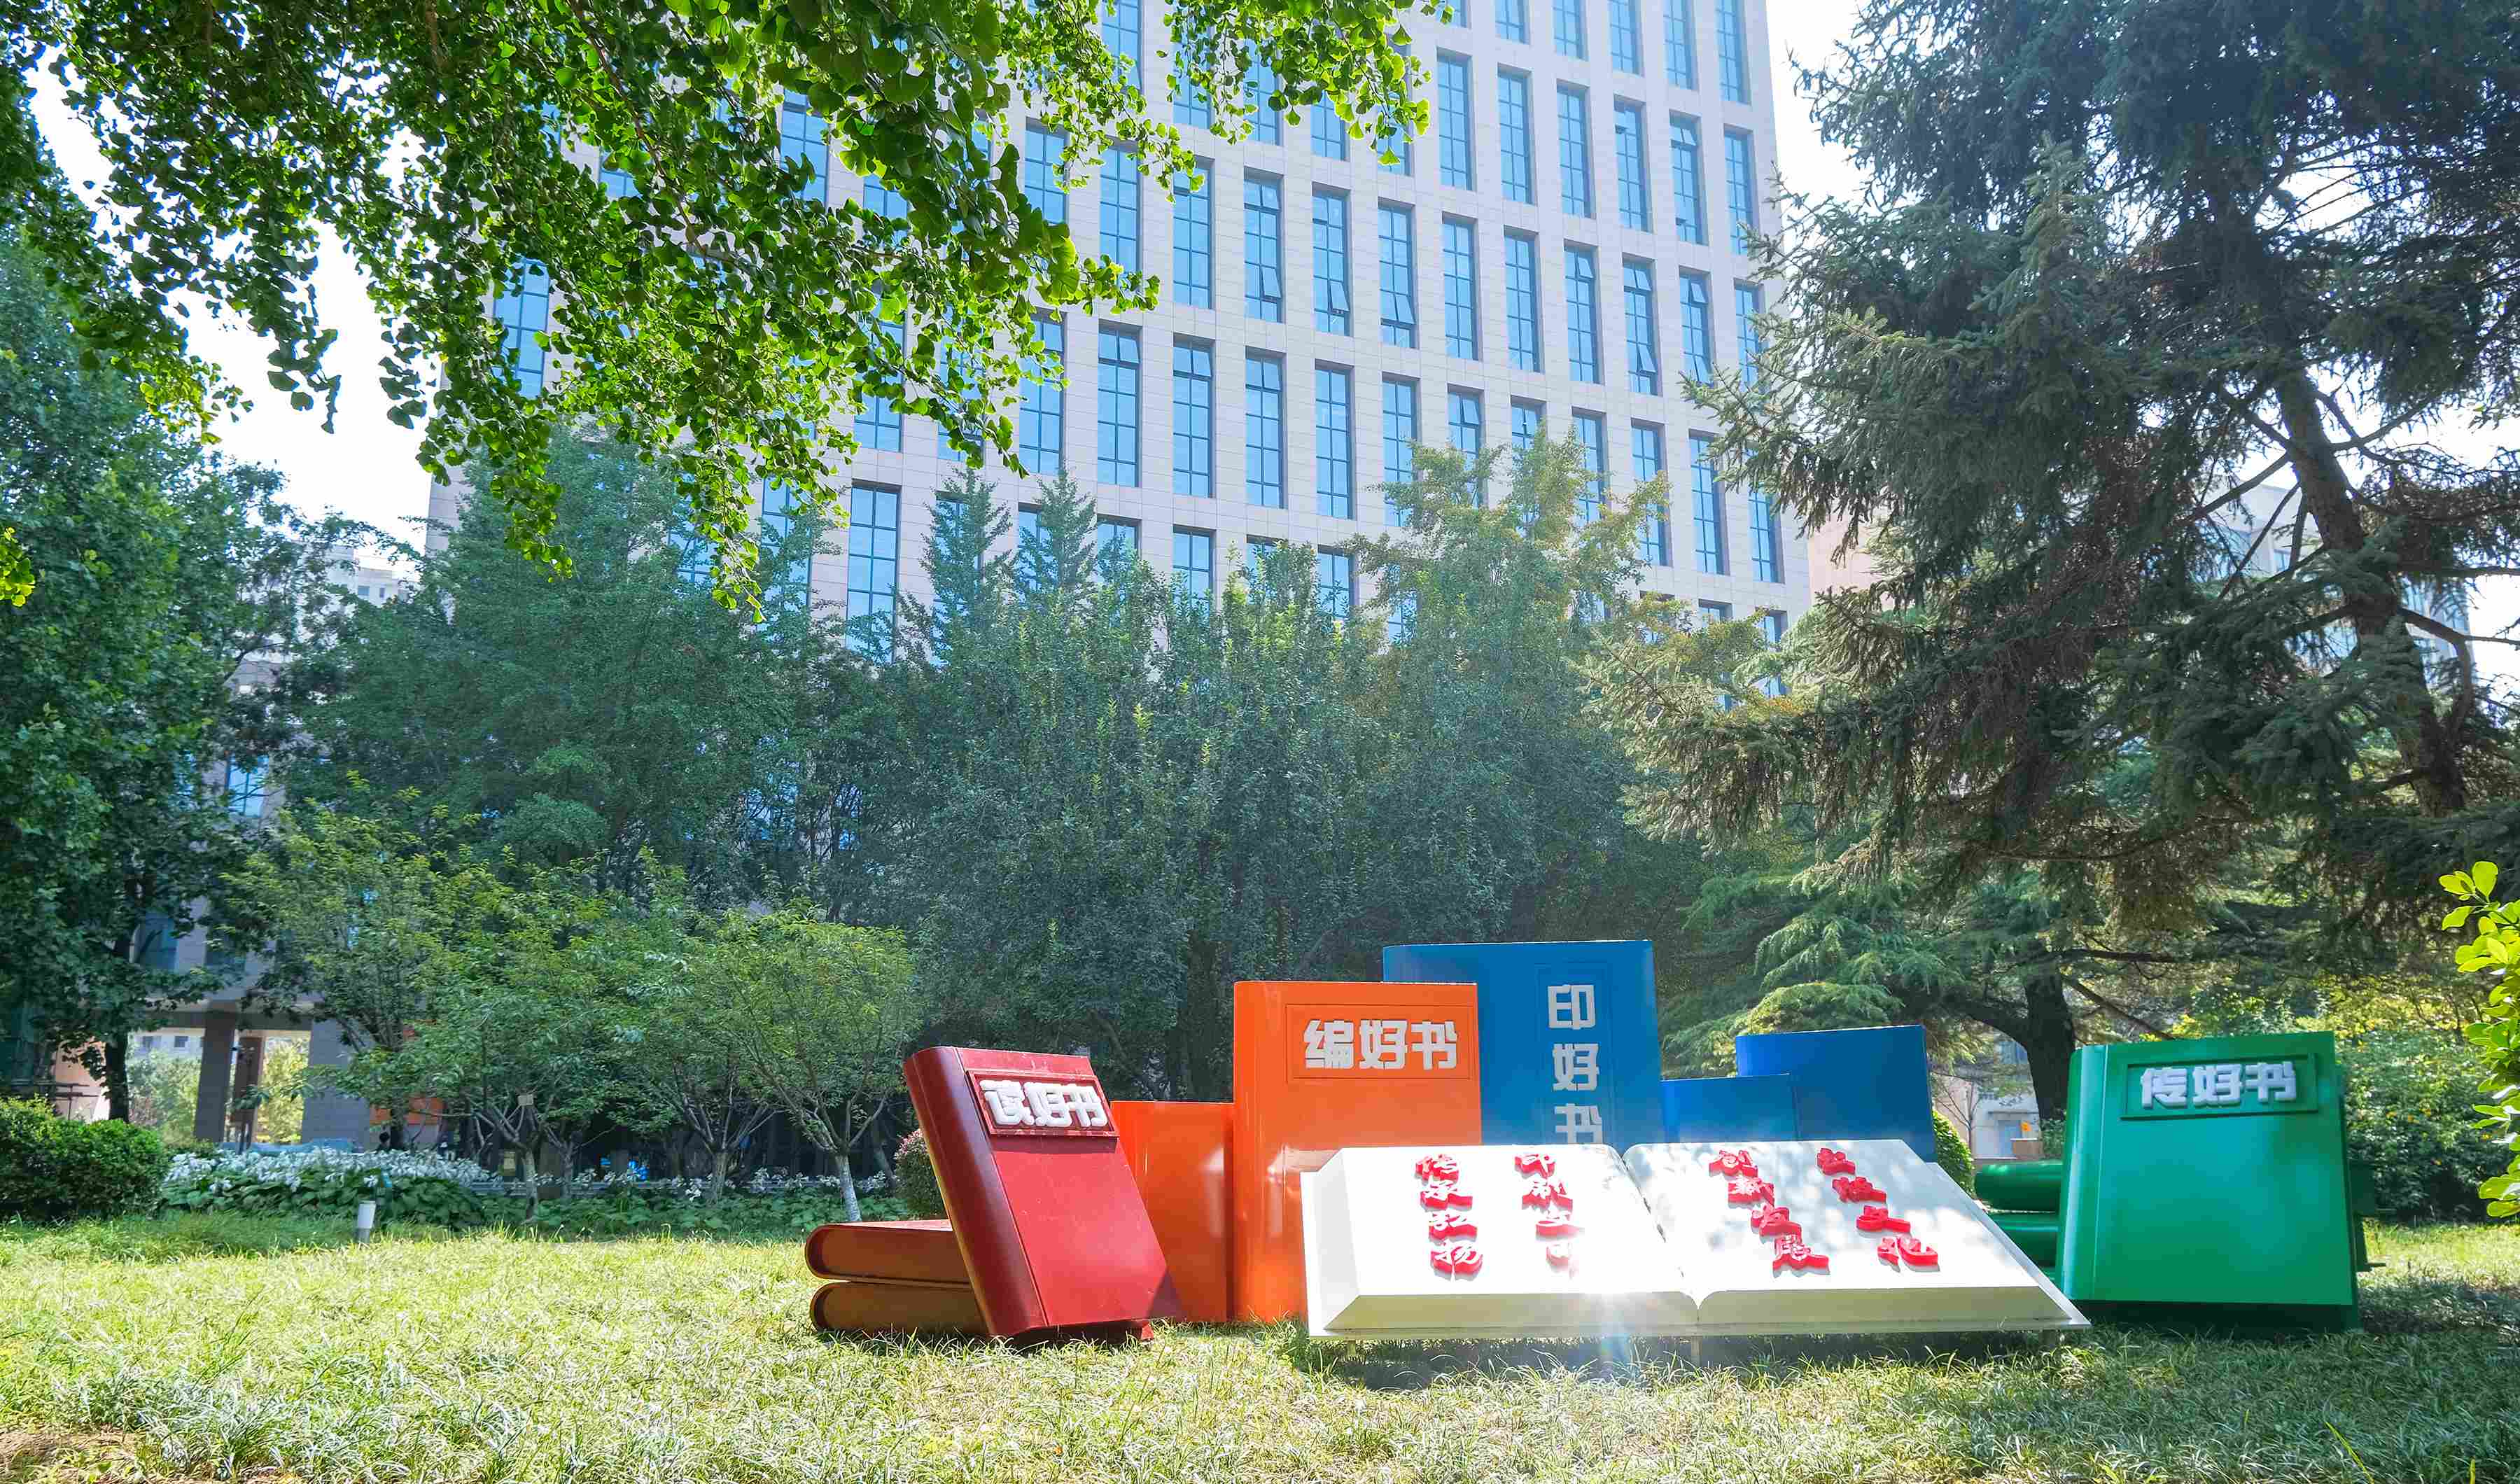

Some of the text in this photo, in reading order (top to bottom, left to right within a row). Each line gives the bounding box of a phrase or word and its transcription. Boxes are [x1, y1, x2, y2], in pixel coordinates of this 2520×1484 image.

[1303, 1019, 1457, 1070] 编好书
[1547, 983, 1603, 1143] 印好书
[979, 1079, 1107, 1128] 读好书
[2140, 1060, 2297, 1110] 传好书
